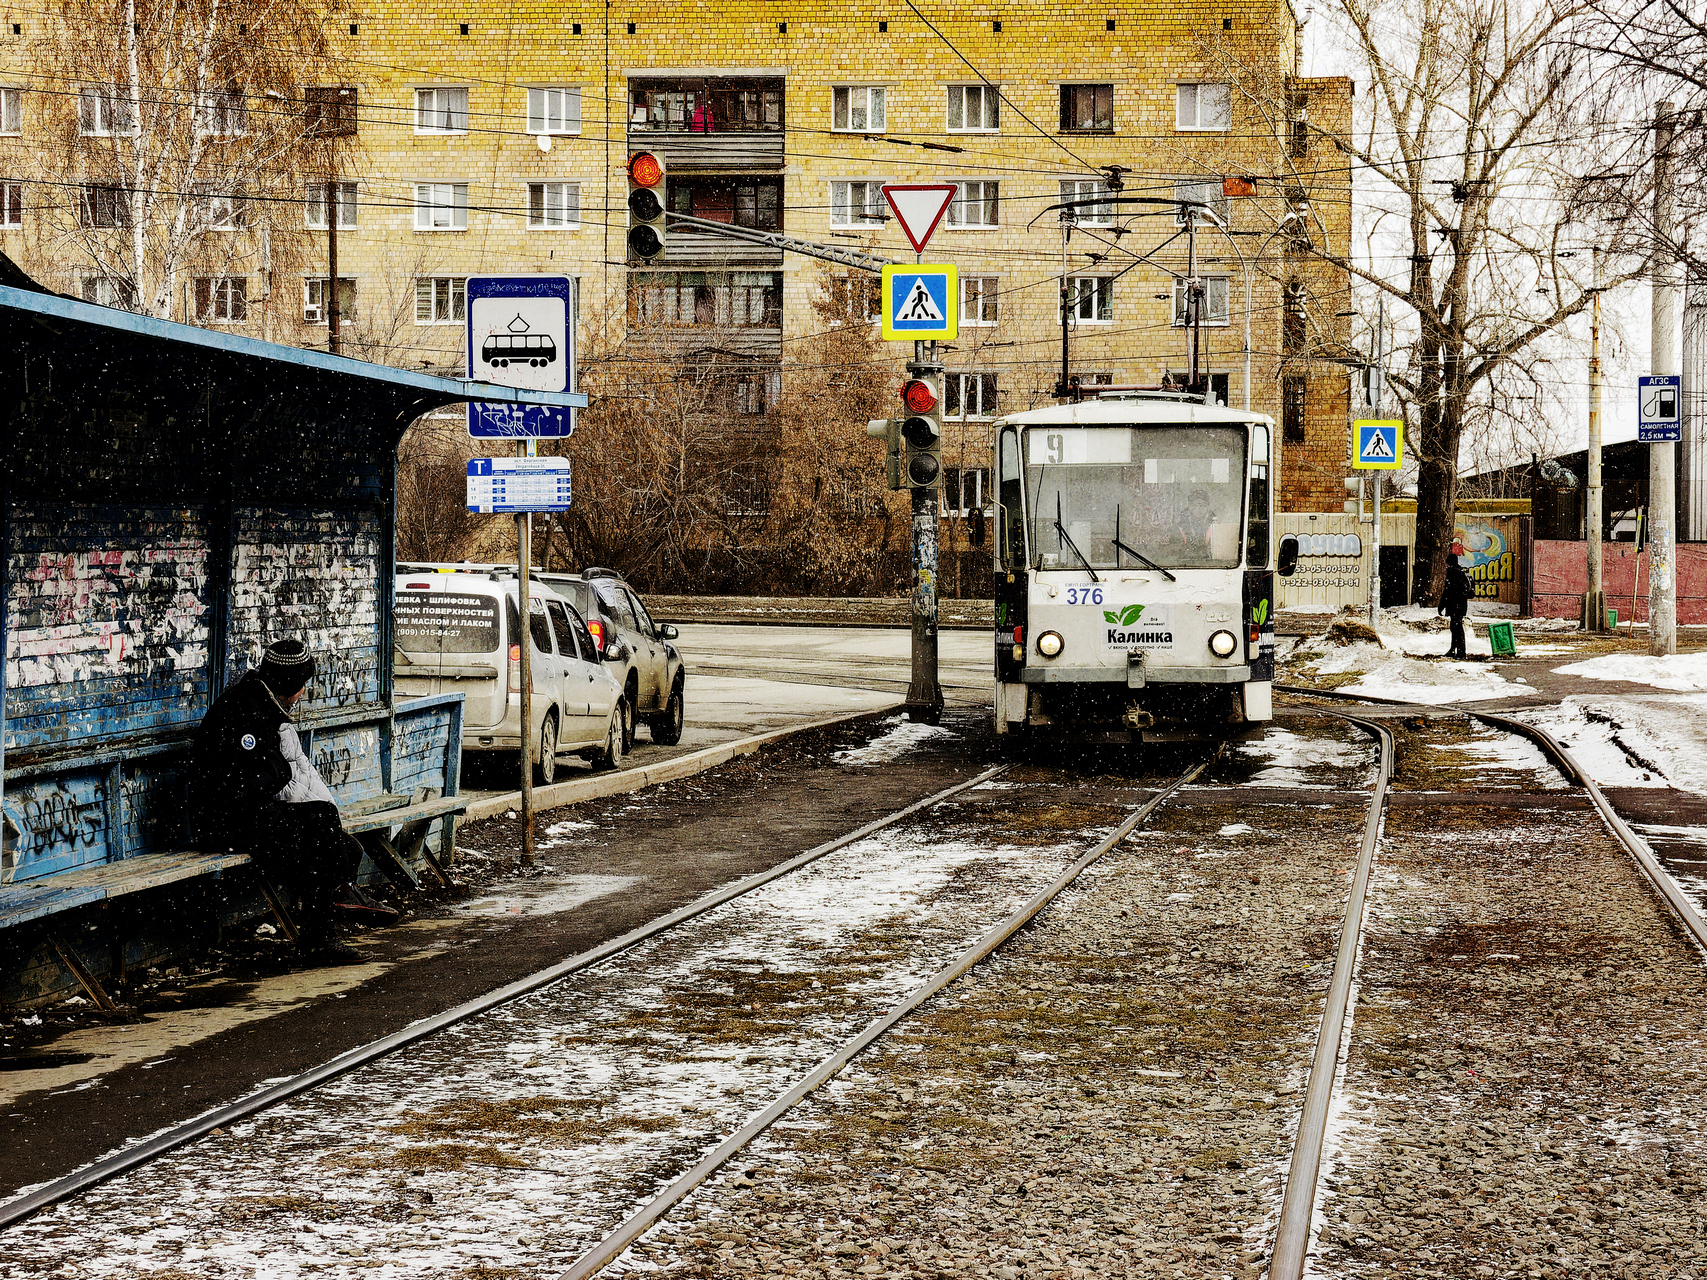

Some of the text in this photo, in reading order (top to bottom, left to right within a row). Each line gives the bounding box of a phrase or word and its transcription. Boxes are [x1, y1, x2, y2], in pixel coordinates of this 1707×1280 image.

[1649, 377, 1669, 385] АГЗС
[1640, 431, 1652, 440] 2,5
[1046, 434, 1064, 464] 9
[1295, 565, 1360, 574] 53-05-00-870
[1067, 588, 1104, 605] 376
[429, 597, 481, 606] ШЛИФОВКА
[422, 607, 494, 617] ПОВЕРХНОСТЕЙ
[411, 618, 449, 626] МАСЛОМ
[460, 619, 492, 628] ЛАКОМ
[397, 628, 461, 637] (909) 015-84-27
[1107, 629, 1173, 644] Калинка
